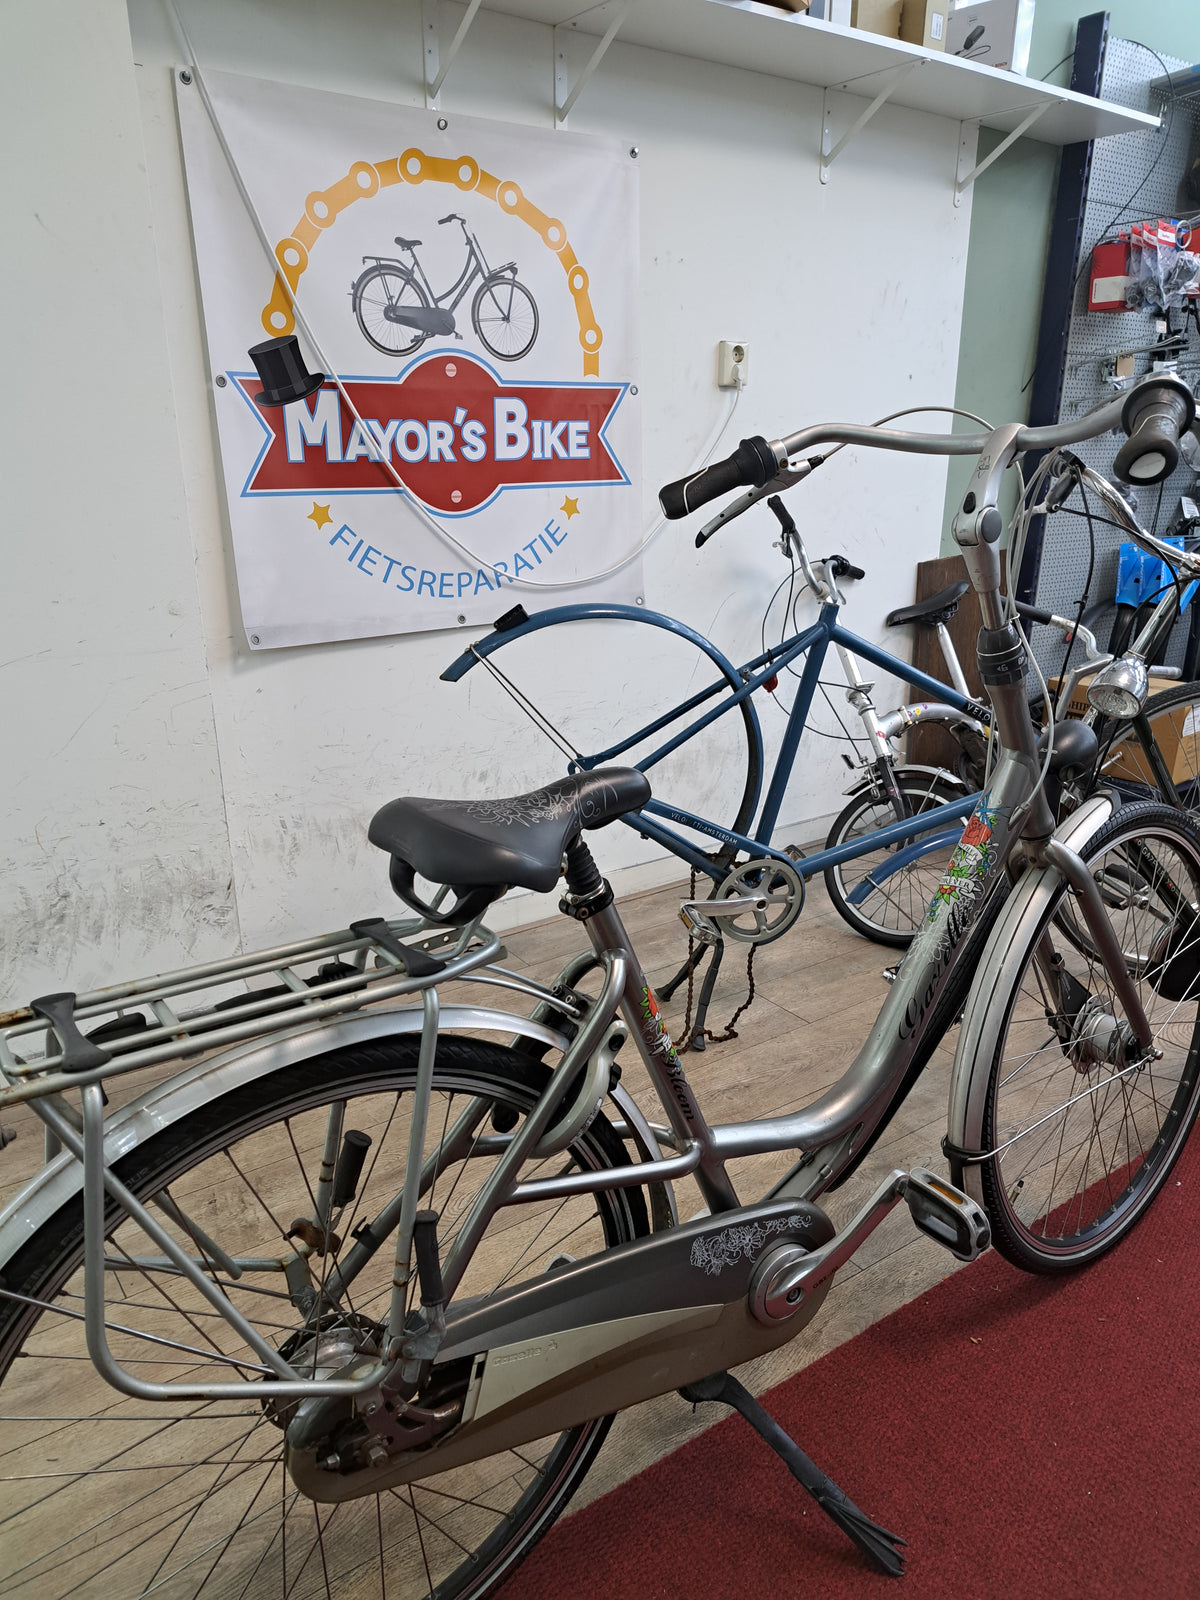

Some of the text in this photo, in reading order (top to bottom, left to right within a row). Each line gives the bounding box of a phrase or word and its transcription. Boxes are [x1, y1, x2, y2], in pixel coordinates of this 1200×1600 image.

[283, 388, 591, 463] MAYOR'S BIKE
[329, 519, 568, 597] FIETSREPARATIE
